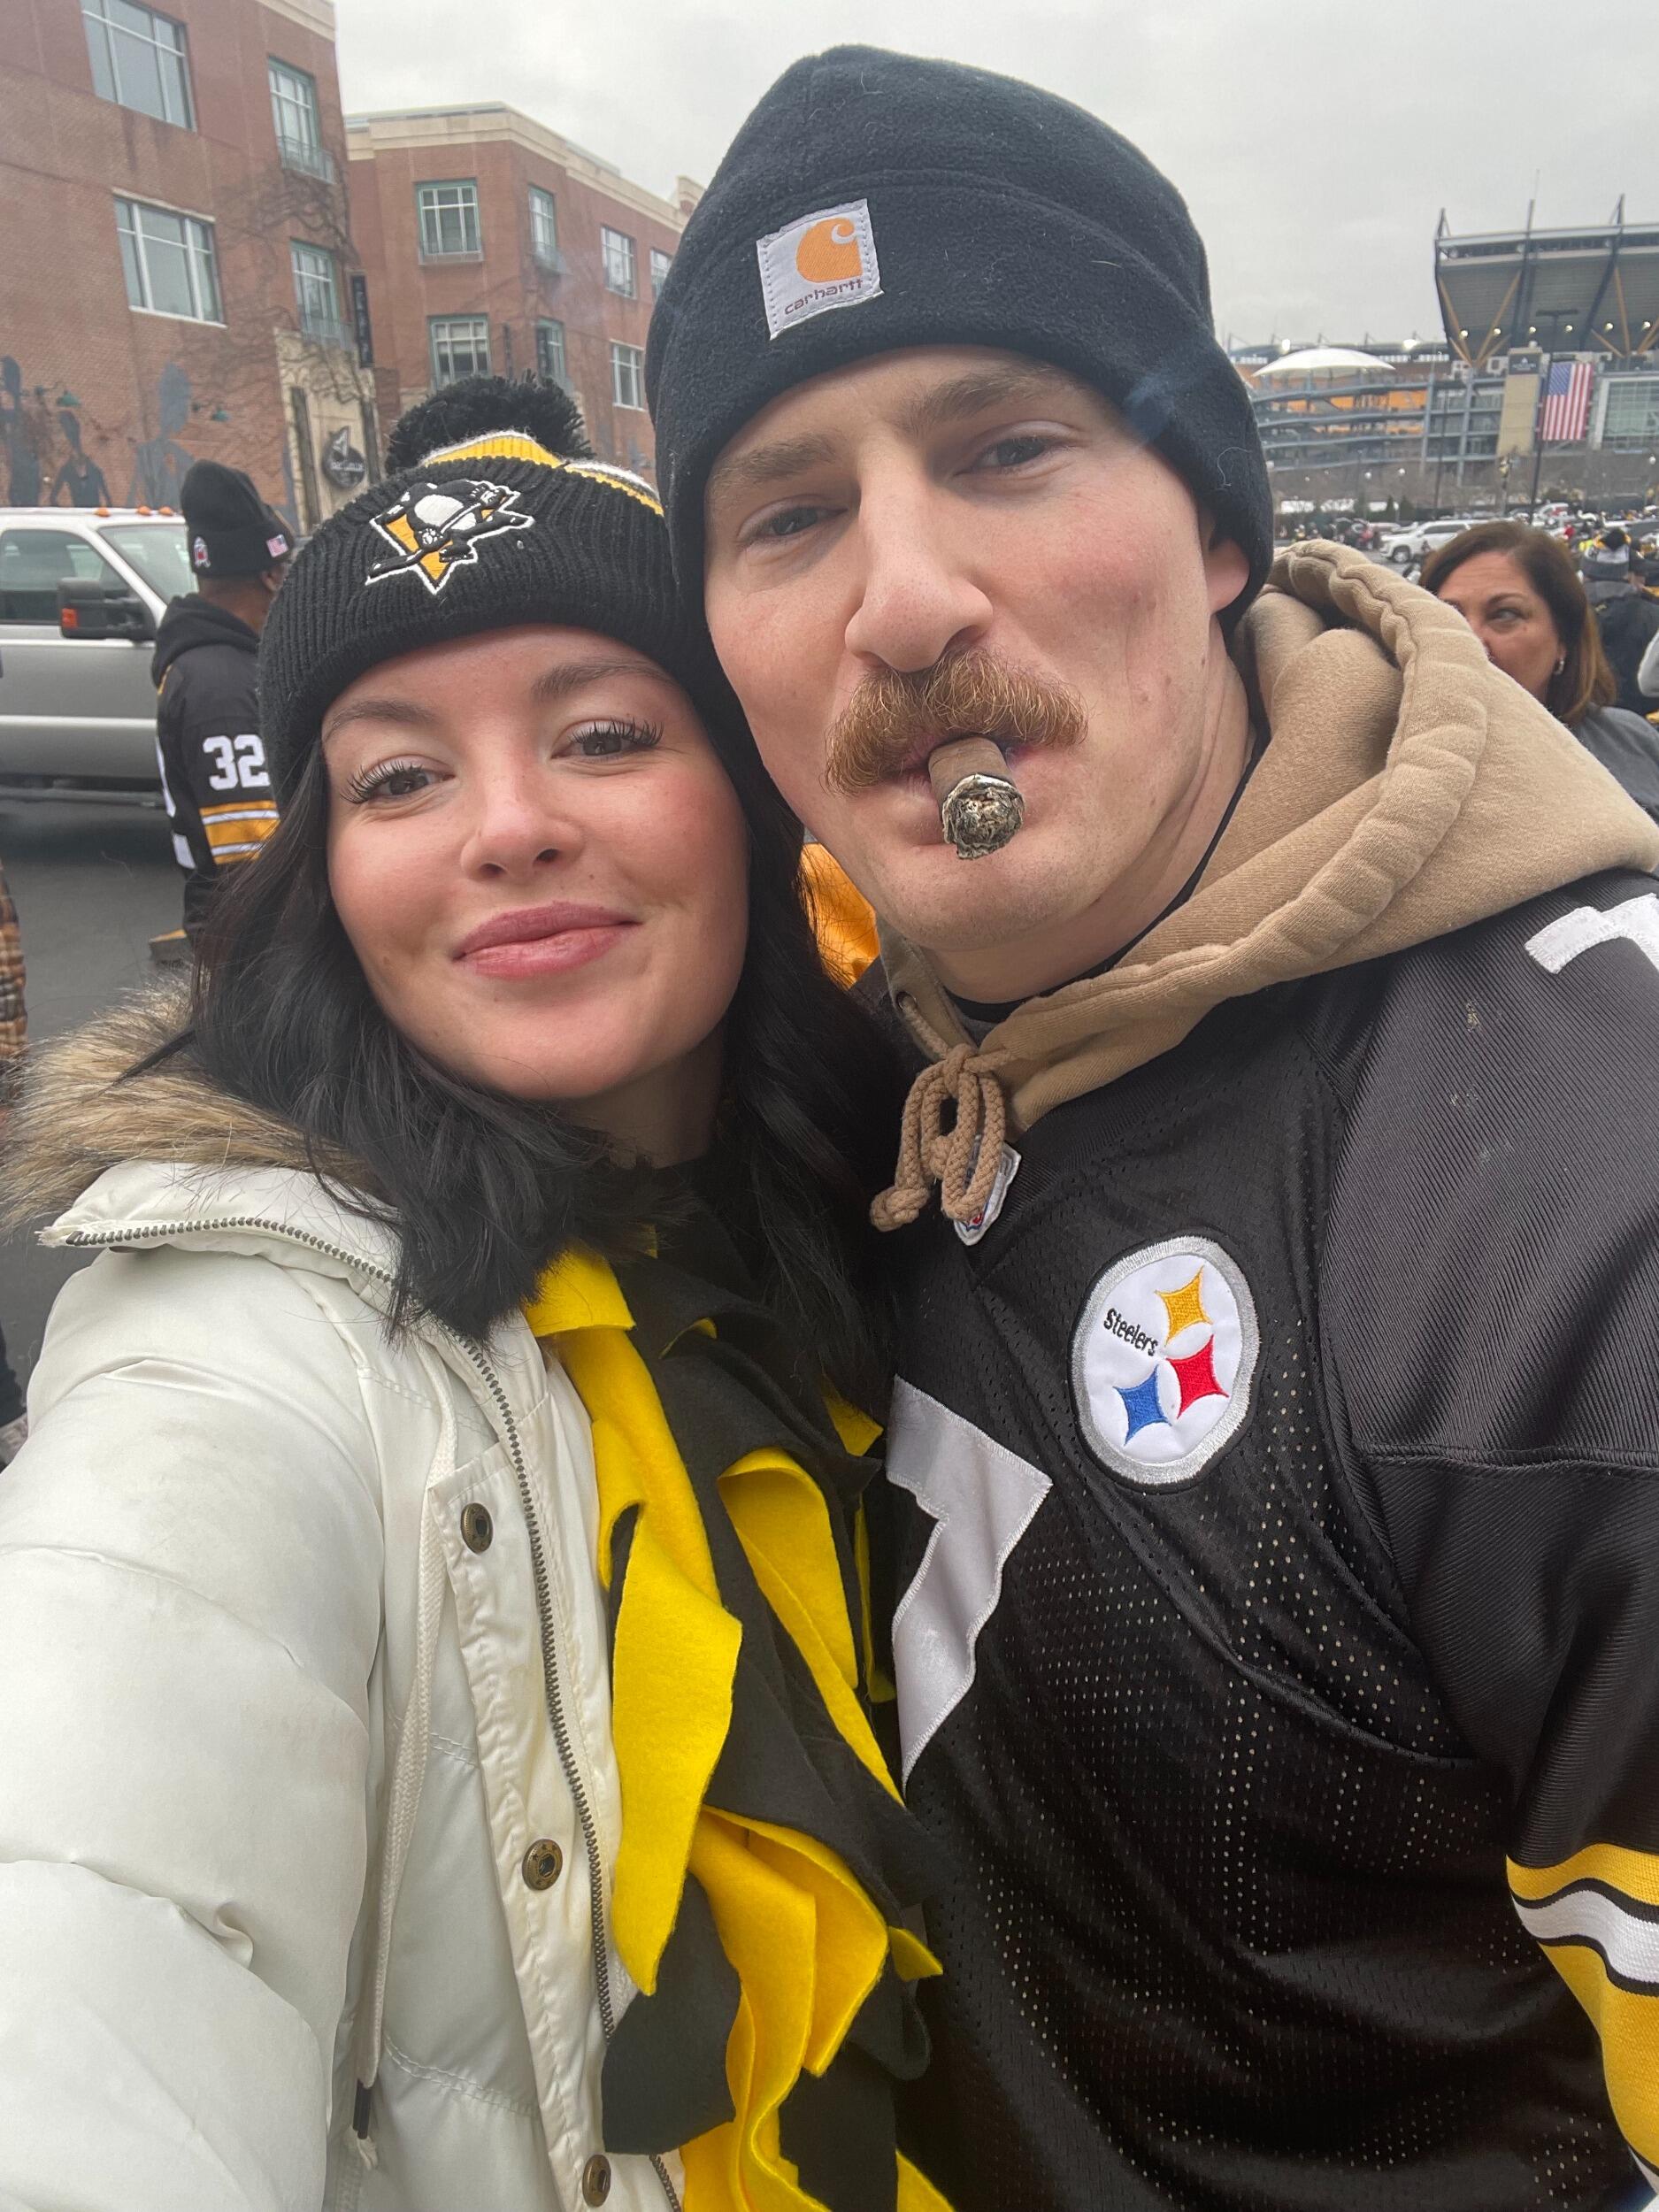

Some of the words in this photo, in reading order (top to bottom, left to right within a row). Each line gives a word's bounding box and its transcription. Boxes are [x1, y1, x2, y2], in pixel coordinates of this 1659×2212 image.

[785, 279, 864, 315] carhartt
[203, 734, 271, 791] 32
[1103, 1308, 1159, 1356] Steelers
